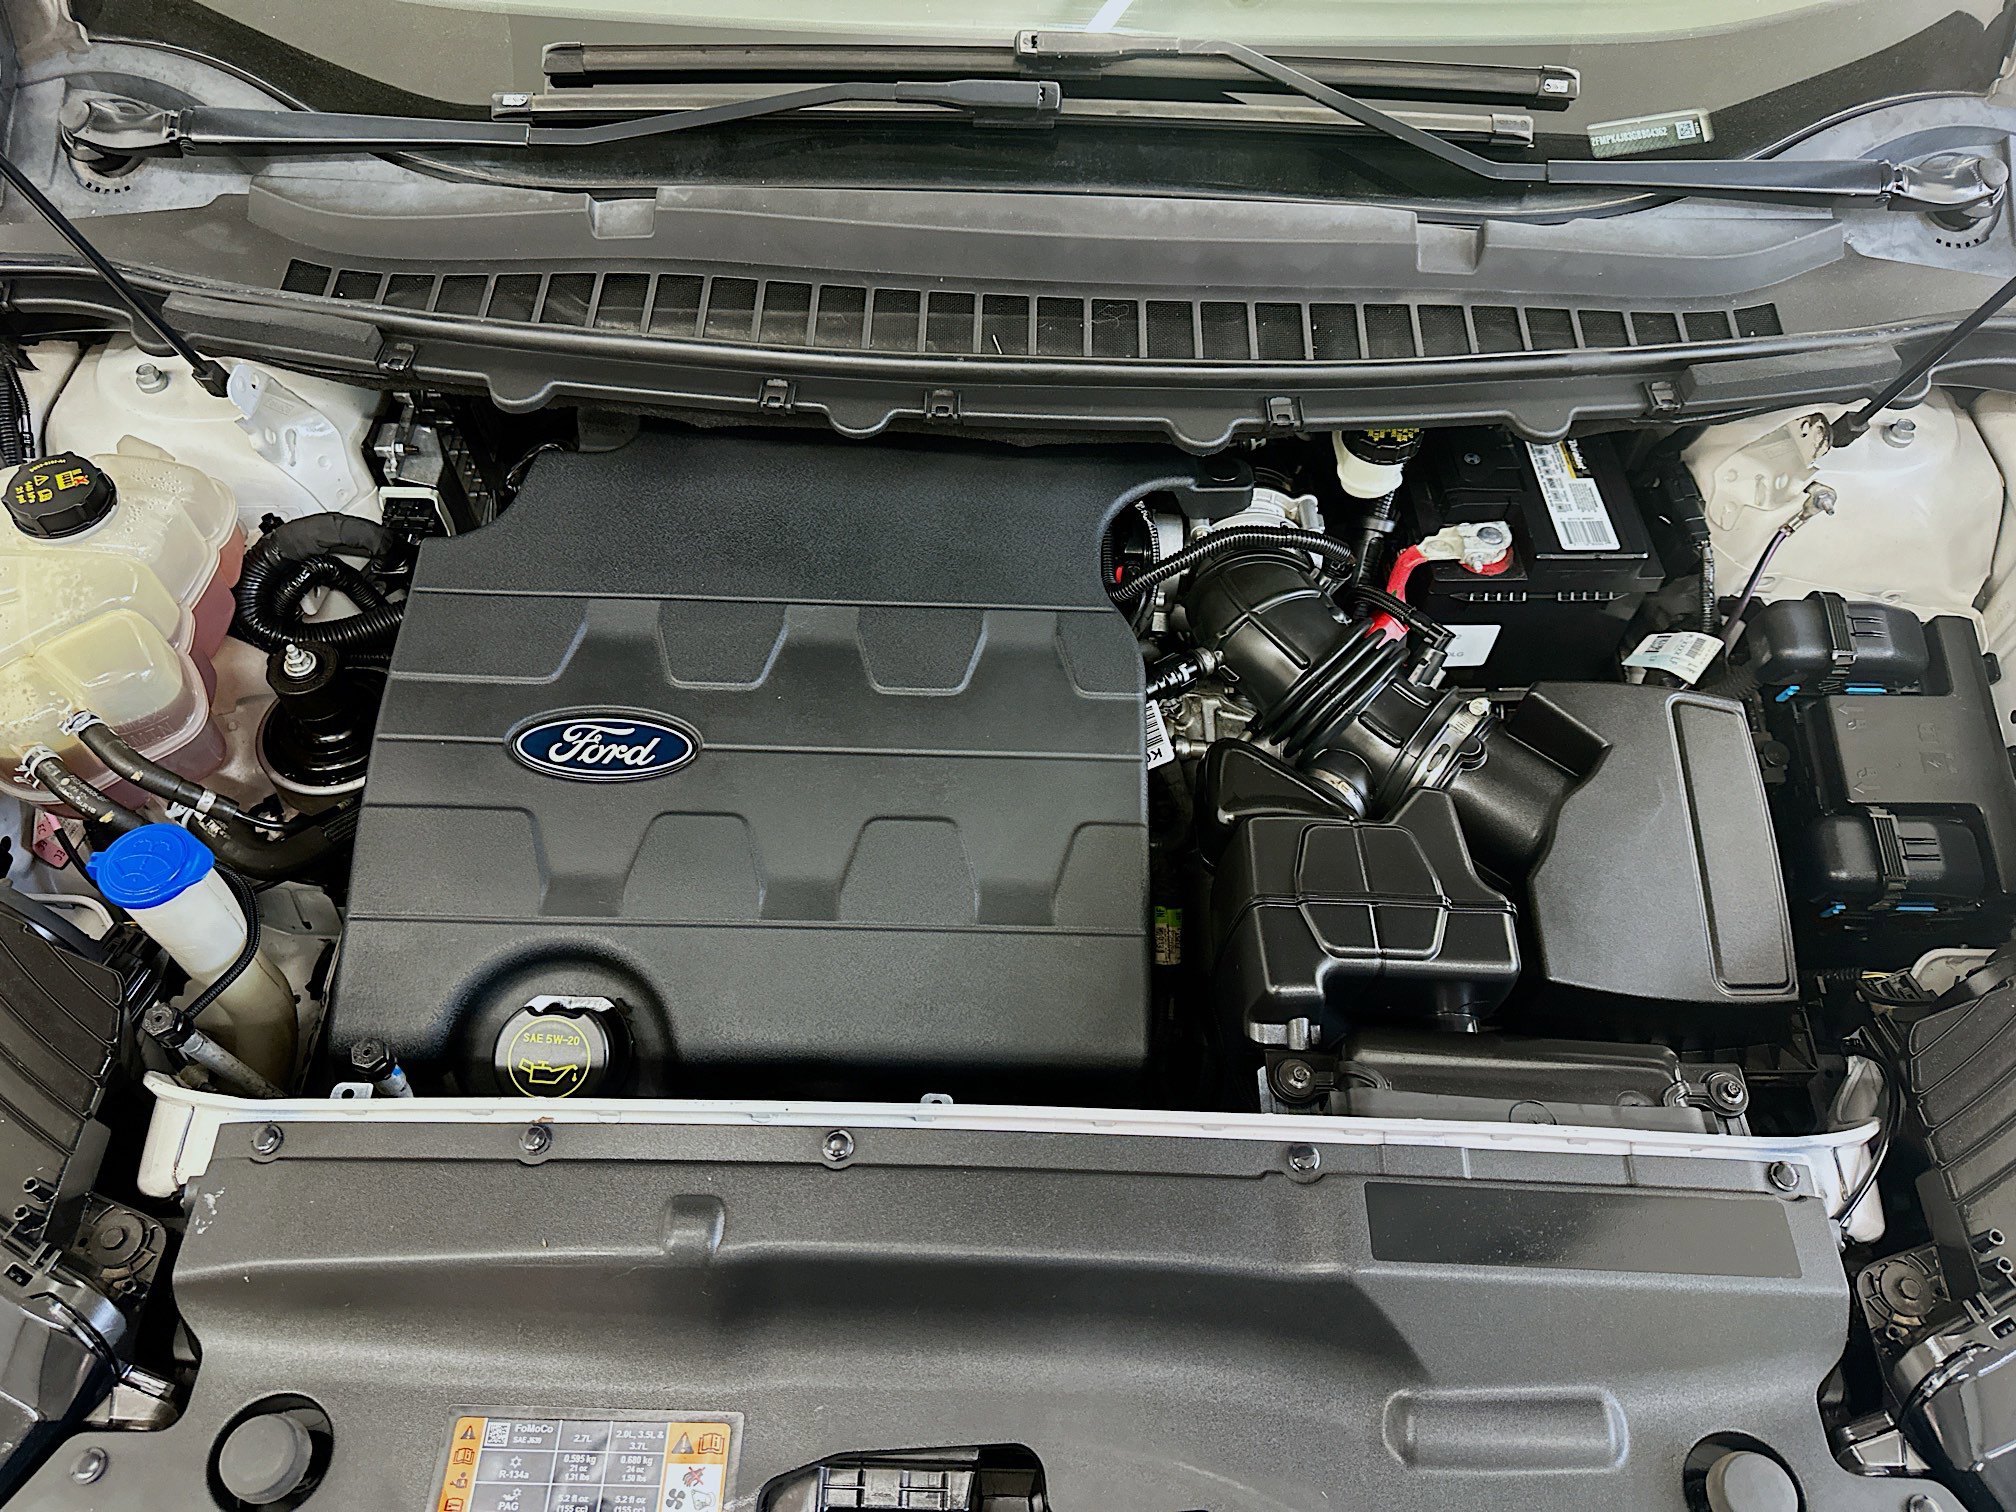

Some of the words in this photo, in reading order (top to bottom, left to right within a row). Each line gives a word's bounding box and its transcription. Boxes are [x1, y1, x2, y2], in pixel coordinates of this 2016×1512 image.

[548, 724, 661, 766] Ford
[523, 1032, 544, 1043] SAE
[546, 1034, 580, 1046] 5W-20
[514, 1423, 554, 1434] FoMoCo
[573, 1435, 592, 1443] 2.7L
[616, 1430, 636, 1439] 2.0L,
[637, 1431, 656, 1440] 3.5L
[657, 1432, 665, 1440] &
[512, 1436, 528, 1444] SAE
[629, 1442, 648, 1450] 3.7L
[586, 1455, 597, 1465] kg
[643, 1457, 653, 1467] kg
[499, 1470, 530, 1479] R-134a
[636, 1475, 647, 1483] lbs
[571, 1494, 577, 1502] fl
[628, 1495, 636, 1503] fl
[498, 1502, 519, 1510] PAG
